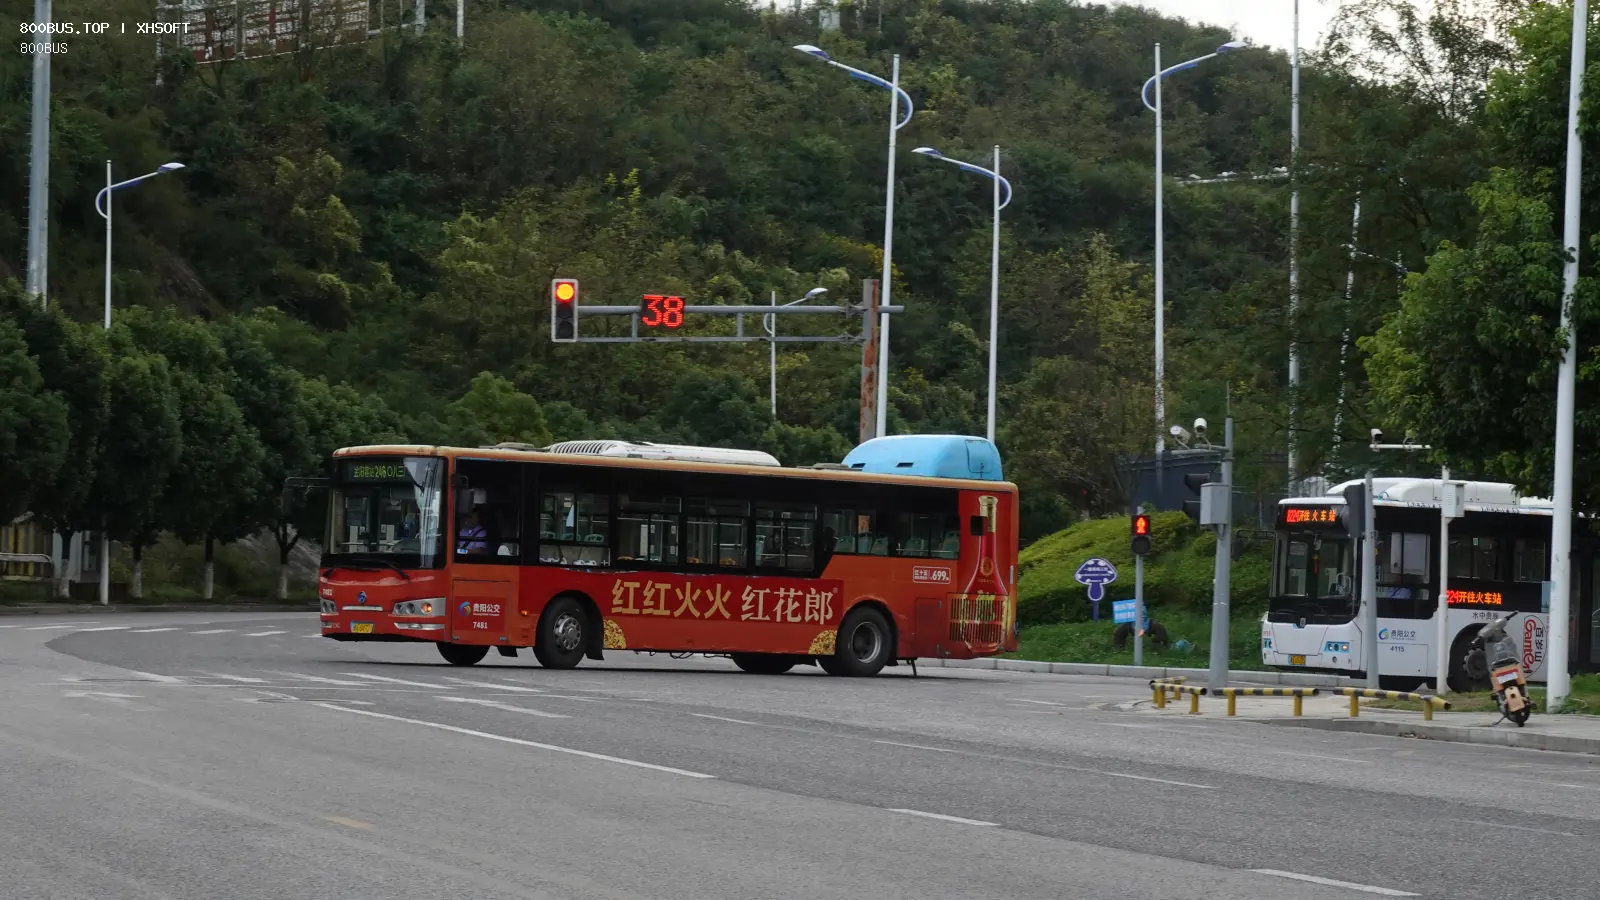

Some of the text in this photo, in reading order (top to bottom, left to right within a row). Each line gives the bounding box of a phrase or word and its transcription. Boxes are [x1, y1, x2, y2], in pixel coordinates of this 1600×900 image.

[641, 294, 684, 328] 38
[473, 603, 501, 613] 贵阳公交
[611, 578, 835, 626] 红红火火 红花郎
[473, 621, 488, 629] 7481
[1391, 629, 1416, 638] 贵阳公交
[1534, 627, 1544, 662] 百岁山
